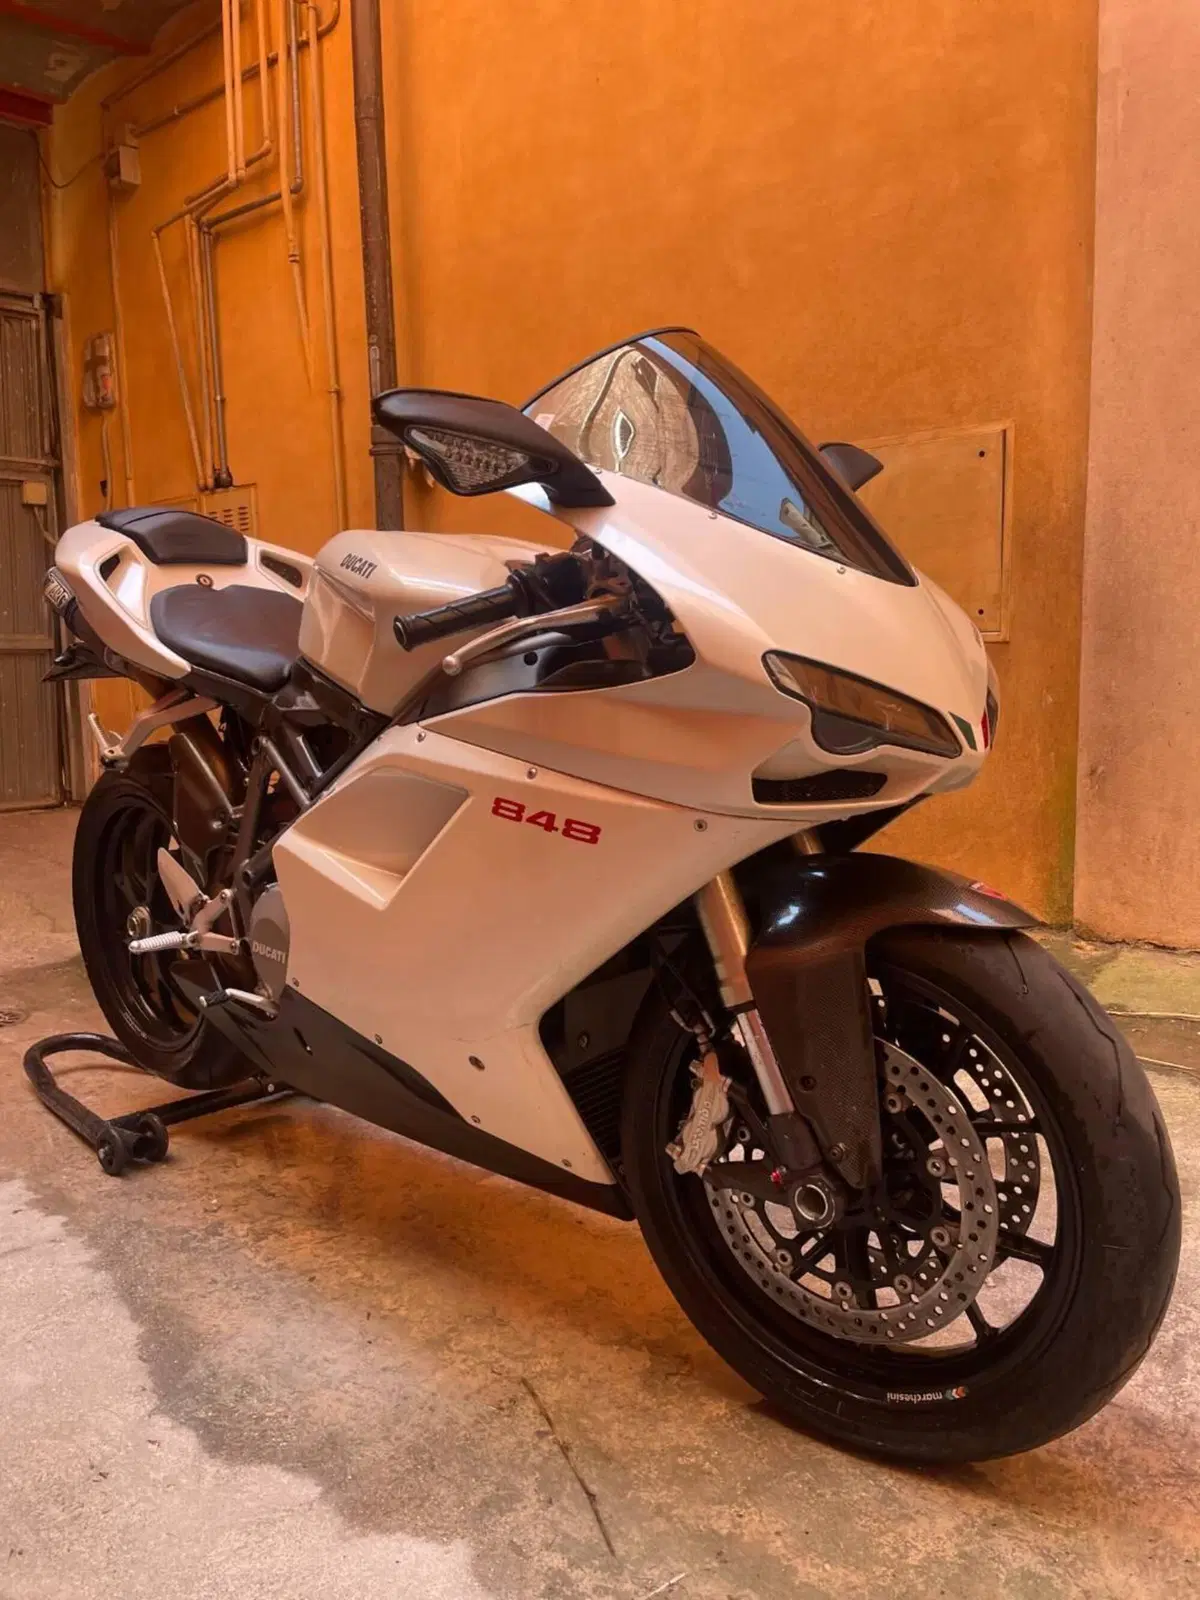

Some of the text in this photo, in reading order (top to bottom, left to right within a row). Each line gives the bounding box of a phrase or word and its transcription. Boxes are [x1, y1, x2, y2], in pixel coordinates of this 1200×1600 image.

[340, 553, 378, 579] DUCATI
[492, 797, 602, 845] 848
[252, 941, 286, 964] DUCATI
[886, 1392, 943, 1404] marchesini
